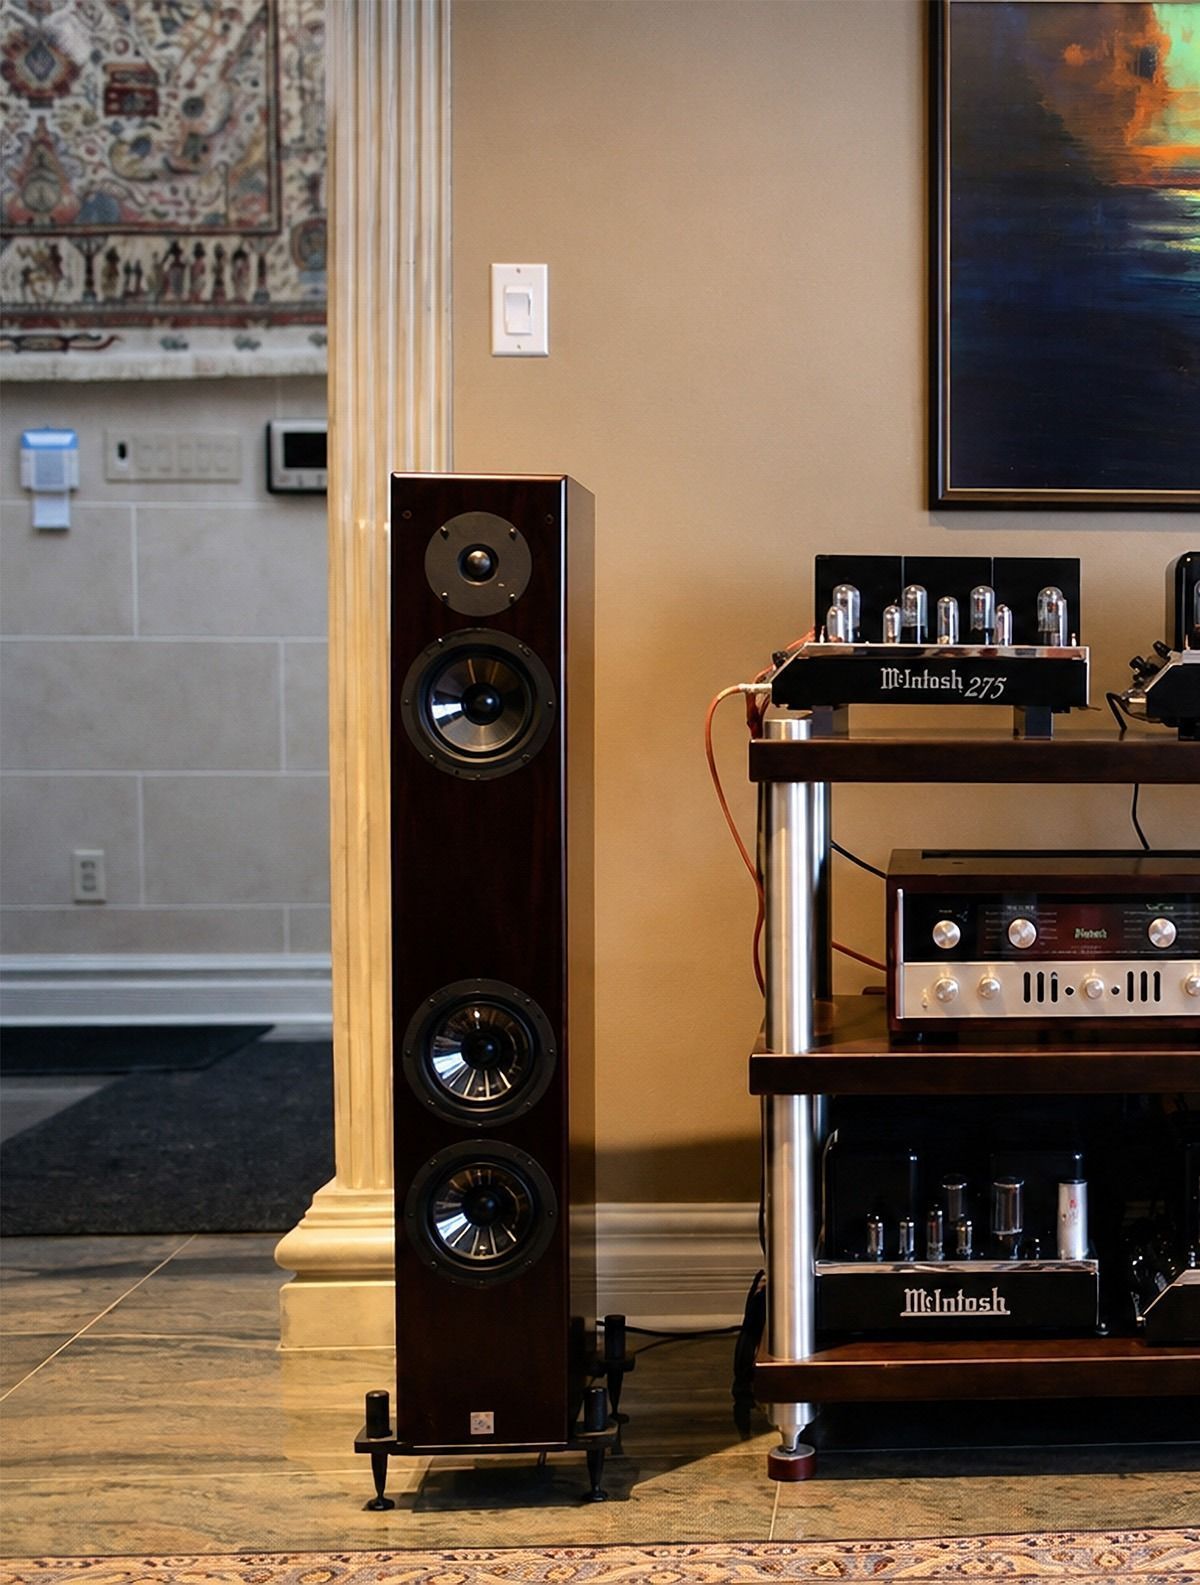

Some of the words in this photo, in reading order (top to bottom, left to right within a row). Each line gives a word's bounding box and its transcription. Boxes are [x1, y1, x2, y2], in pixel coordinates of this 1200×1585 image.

[880, 667, 963, 693] McIntosh
[964, 676, 1007, 699] 275
[900, 1286, 1011, 1316] McIntosh
